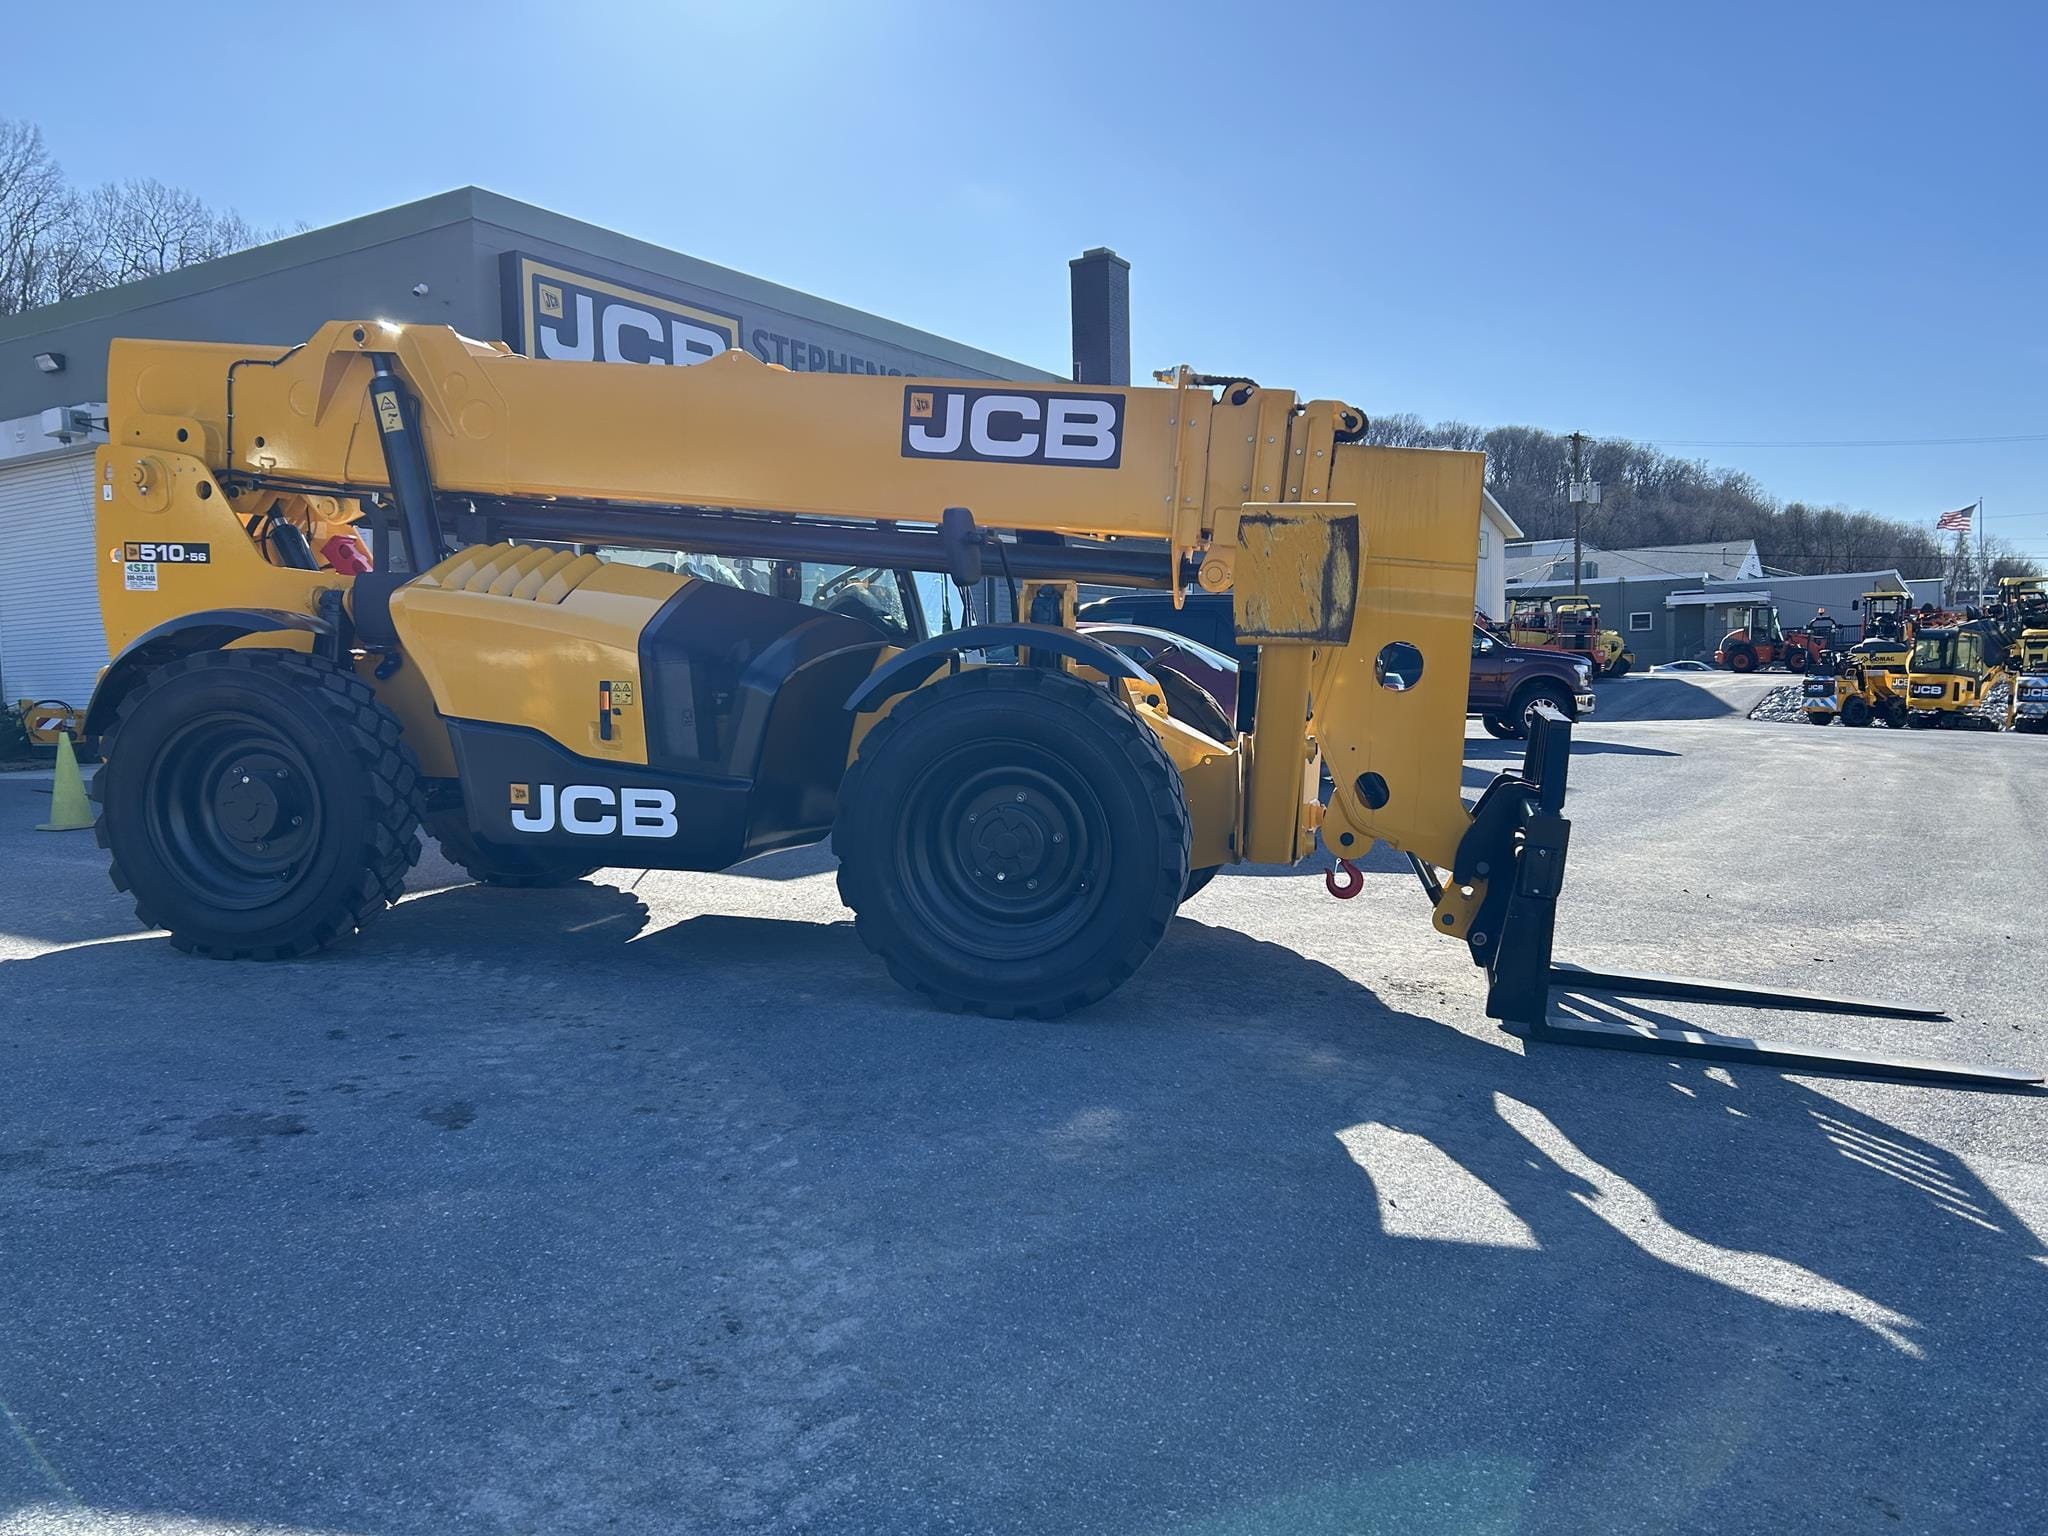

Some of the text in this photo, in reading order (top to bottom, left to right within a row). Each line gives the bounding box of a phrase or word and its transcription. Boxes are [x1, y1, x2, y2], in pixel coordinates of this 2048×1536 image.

[540, 293, 727, 366] JCB
[909, 394, 1116, 461] JCB
[140, 544, 207, 562] 510-56
[1913, 685, 1942, 695] JCB
[511, 784, 678, 838] JCB
